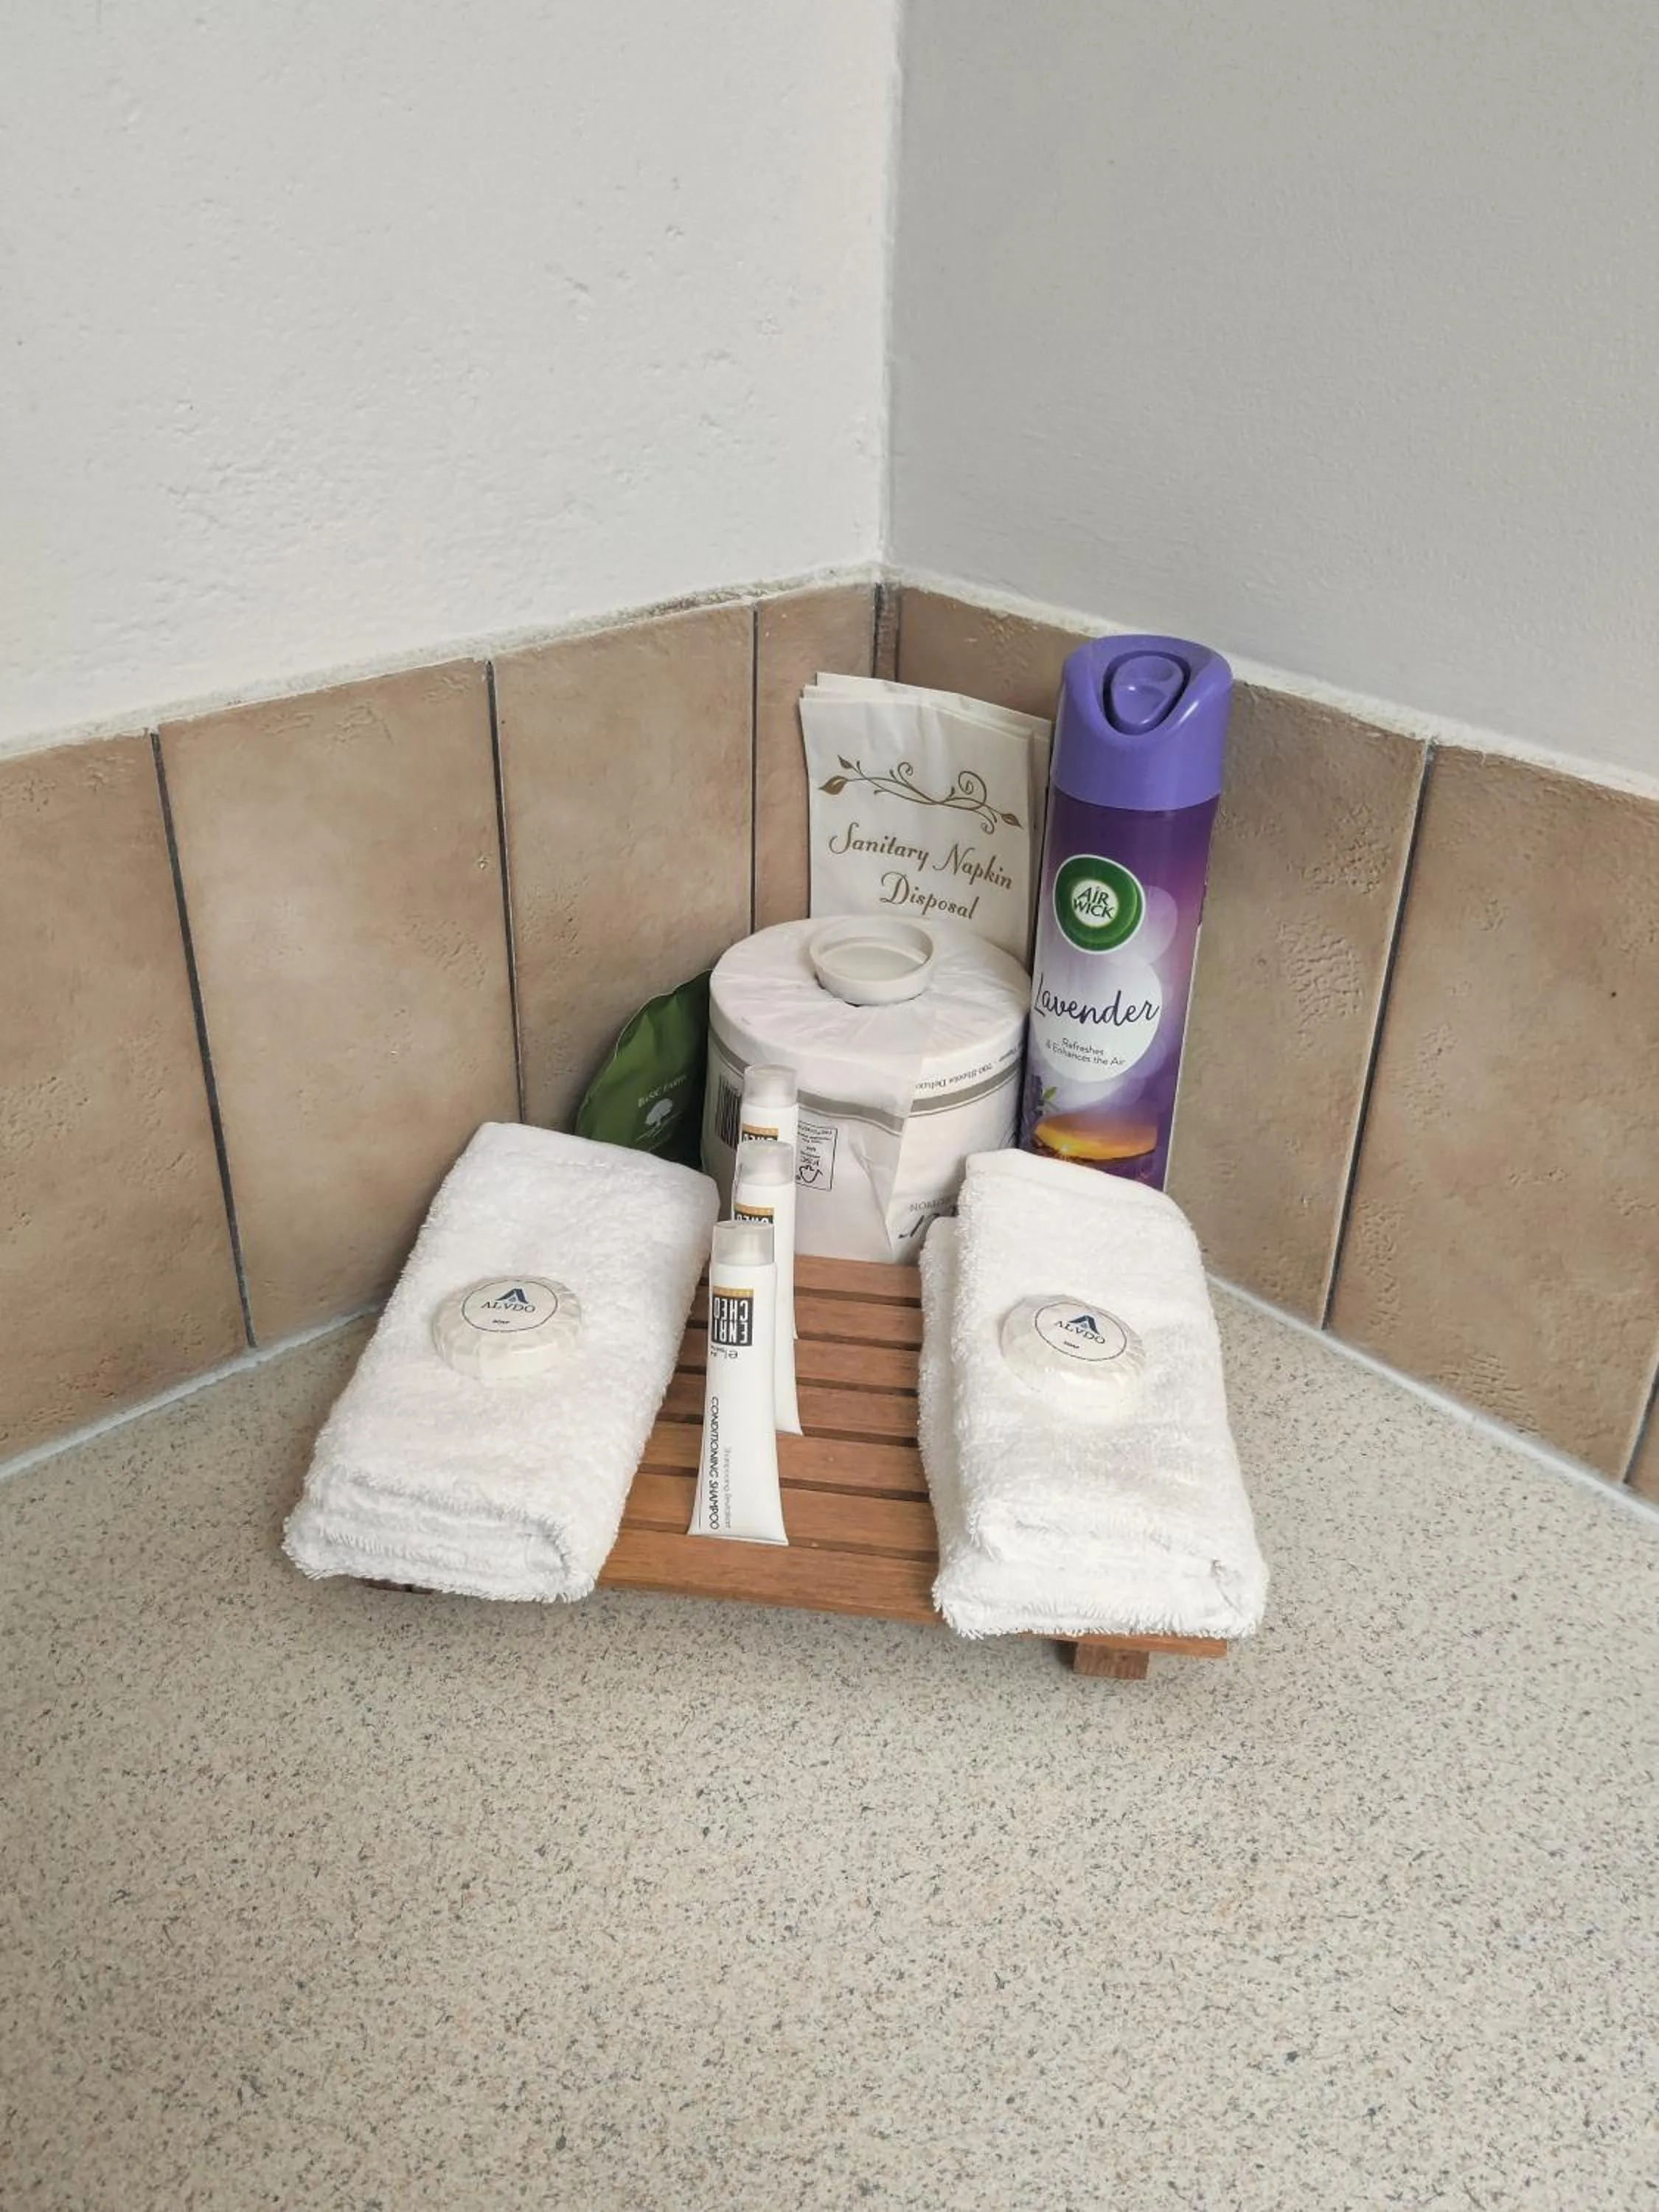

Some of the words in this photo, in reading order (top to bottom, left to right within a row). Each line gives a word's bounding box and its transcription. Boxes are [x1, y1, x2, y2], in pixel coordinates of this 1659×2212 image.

[829, 822, 929, 871] Sanitary
[932, 843, 1012, 890] Napkin
[879, 872, 979, 919] Disposal
[1077, 886, 1108, 905] AIR
[1074, 898, 1114, 919] WICK
[1034, 972, 1160, 1026] Lavender
[1053, 1043, 1091, 1062] Enhances
[1093, 1054, 1108, 1065] the
[1110, 1057, 1127, 1066] Air
[1062, 1037, 1104, 1056] Refreshes
[714, 1297, 748, 1322] CHED
[714, 1319, 748, 1344] ENRI
[709, 1396, 720, 1478] CONDITIONING
[709, 1480, 720, 1530] SHAMPOO
